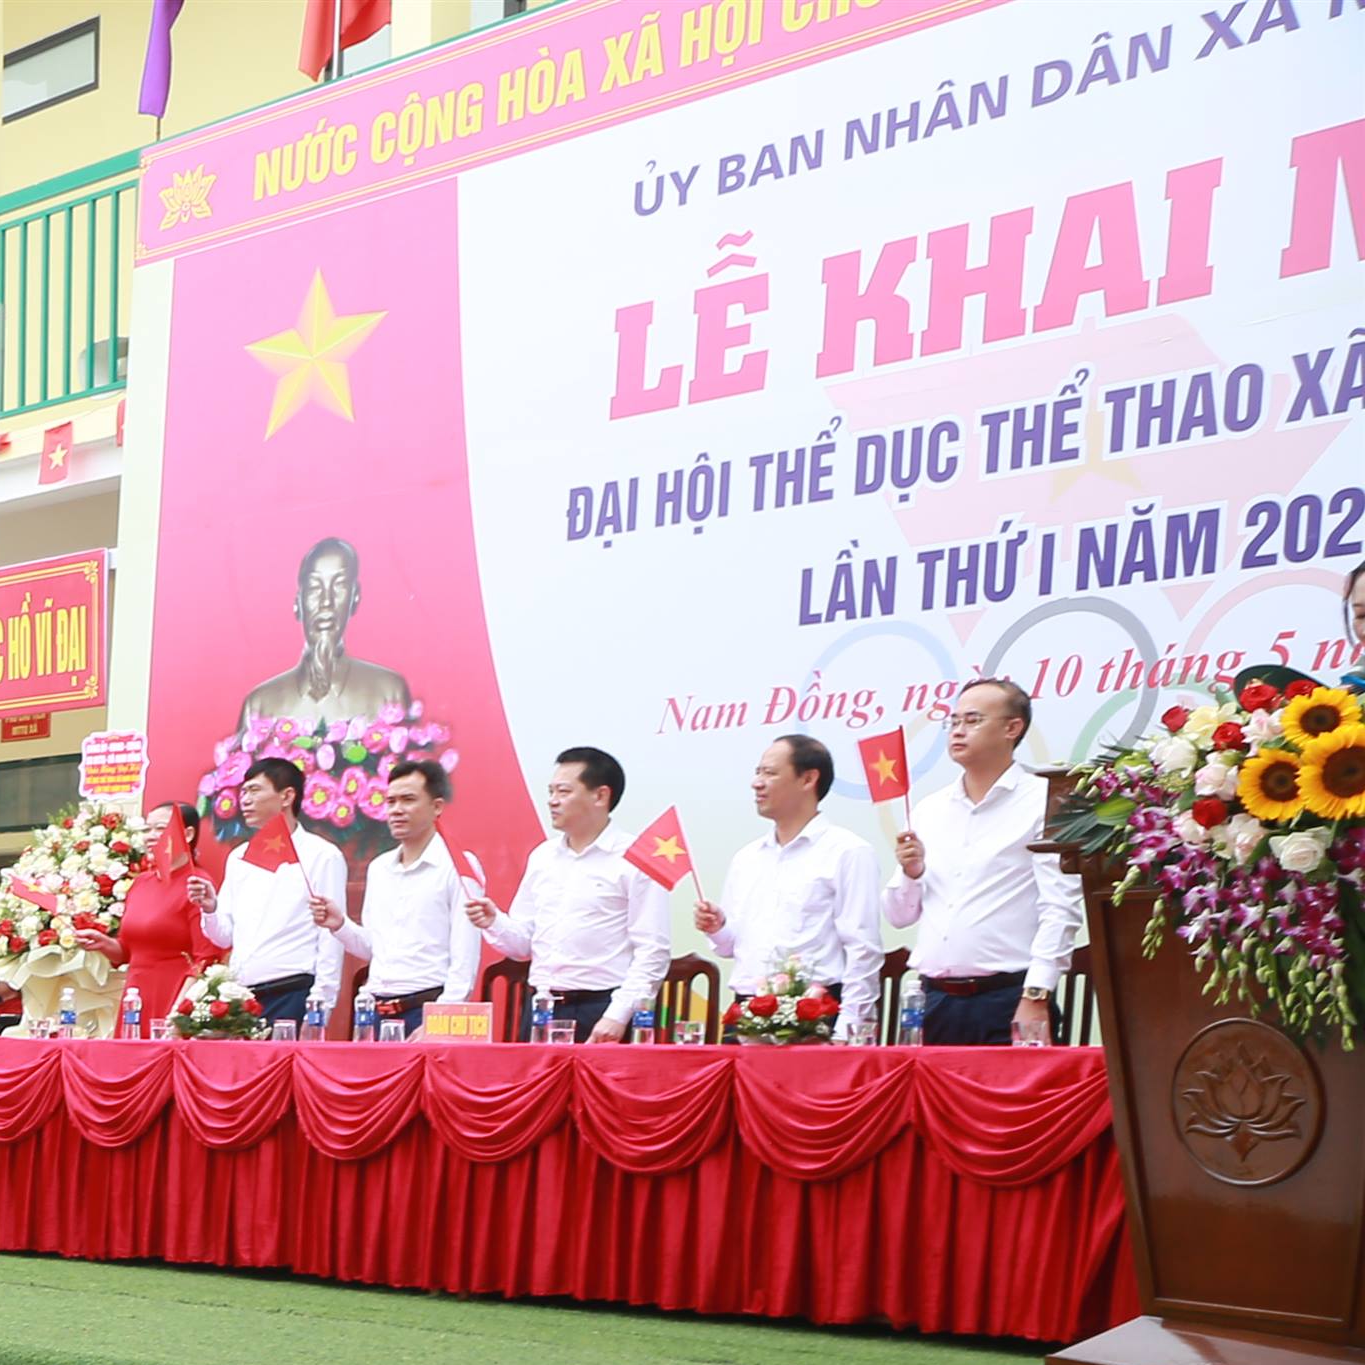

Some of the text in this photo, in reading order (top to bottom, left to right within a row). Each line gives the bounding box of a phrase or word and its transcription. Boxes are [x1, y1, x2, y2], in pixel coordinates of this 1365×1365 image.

[252, 117, 358, 201] NƯỚC
[369, 82, 484, 167] CỘNG
[496, 46, 586, 125] HÒA
[599, 12, 665, 93] XÃ
[633, 159, 700, 217] ỦY
[717, 128, 825, 196] BAN
[843, 74, 1010, 161] NHÂN
[1031, 24, 1173, 108] DÂN
[609, 229, 770, 420] LỄ
[815, 157, 1224, 379] KHAI
[566, 476, 639, 549] ĐẠI
[654, 452, 732, 535] HỘI
[749, 415, 843, 512] THỂ
[854, 420, 960, 503] DỤC
[980, 368, 1090, 475] THỂ
[1104, 362, 1264, 454] THAO
[8, 591, 31, 680] HỒ
[35, 597, 52, 677] VĨ
[56, 604, 87, 687] ĐẠI
[798, 539, 898, 626] LẦN
[917, 519, 1029, 611] THỨ
[1038, 532, 1056, 597] I
[1075, 503, 1221, 592] NĂM
[656, 694, 749, 735] Nam
[760, 670, 884, 727] Đồng,
[1030, 653, 1083, 700] 10
[1096, 642, 1246, 695] tháng
